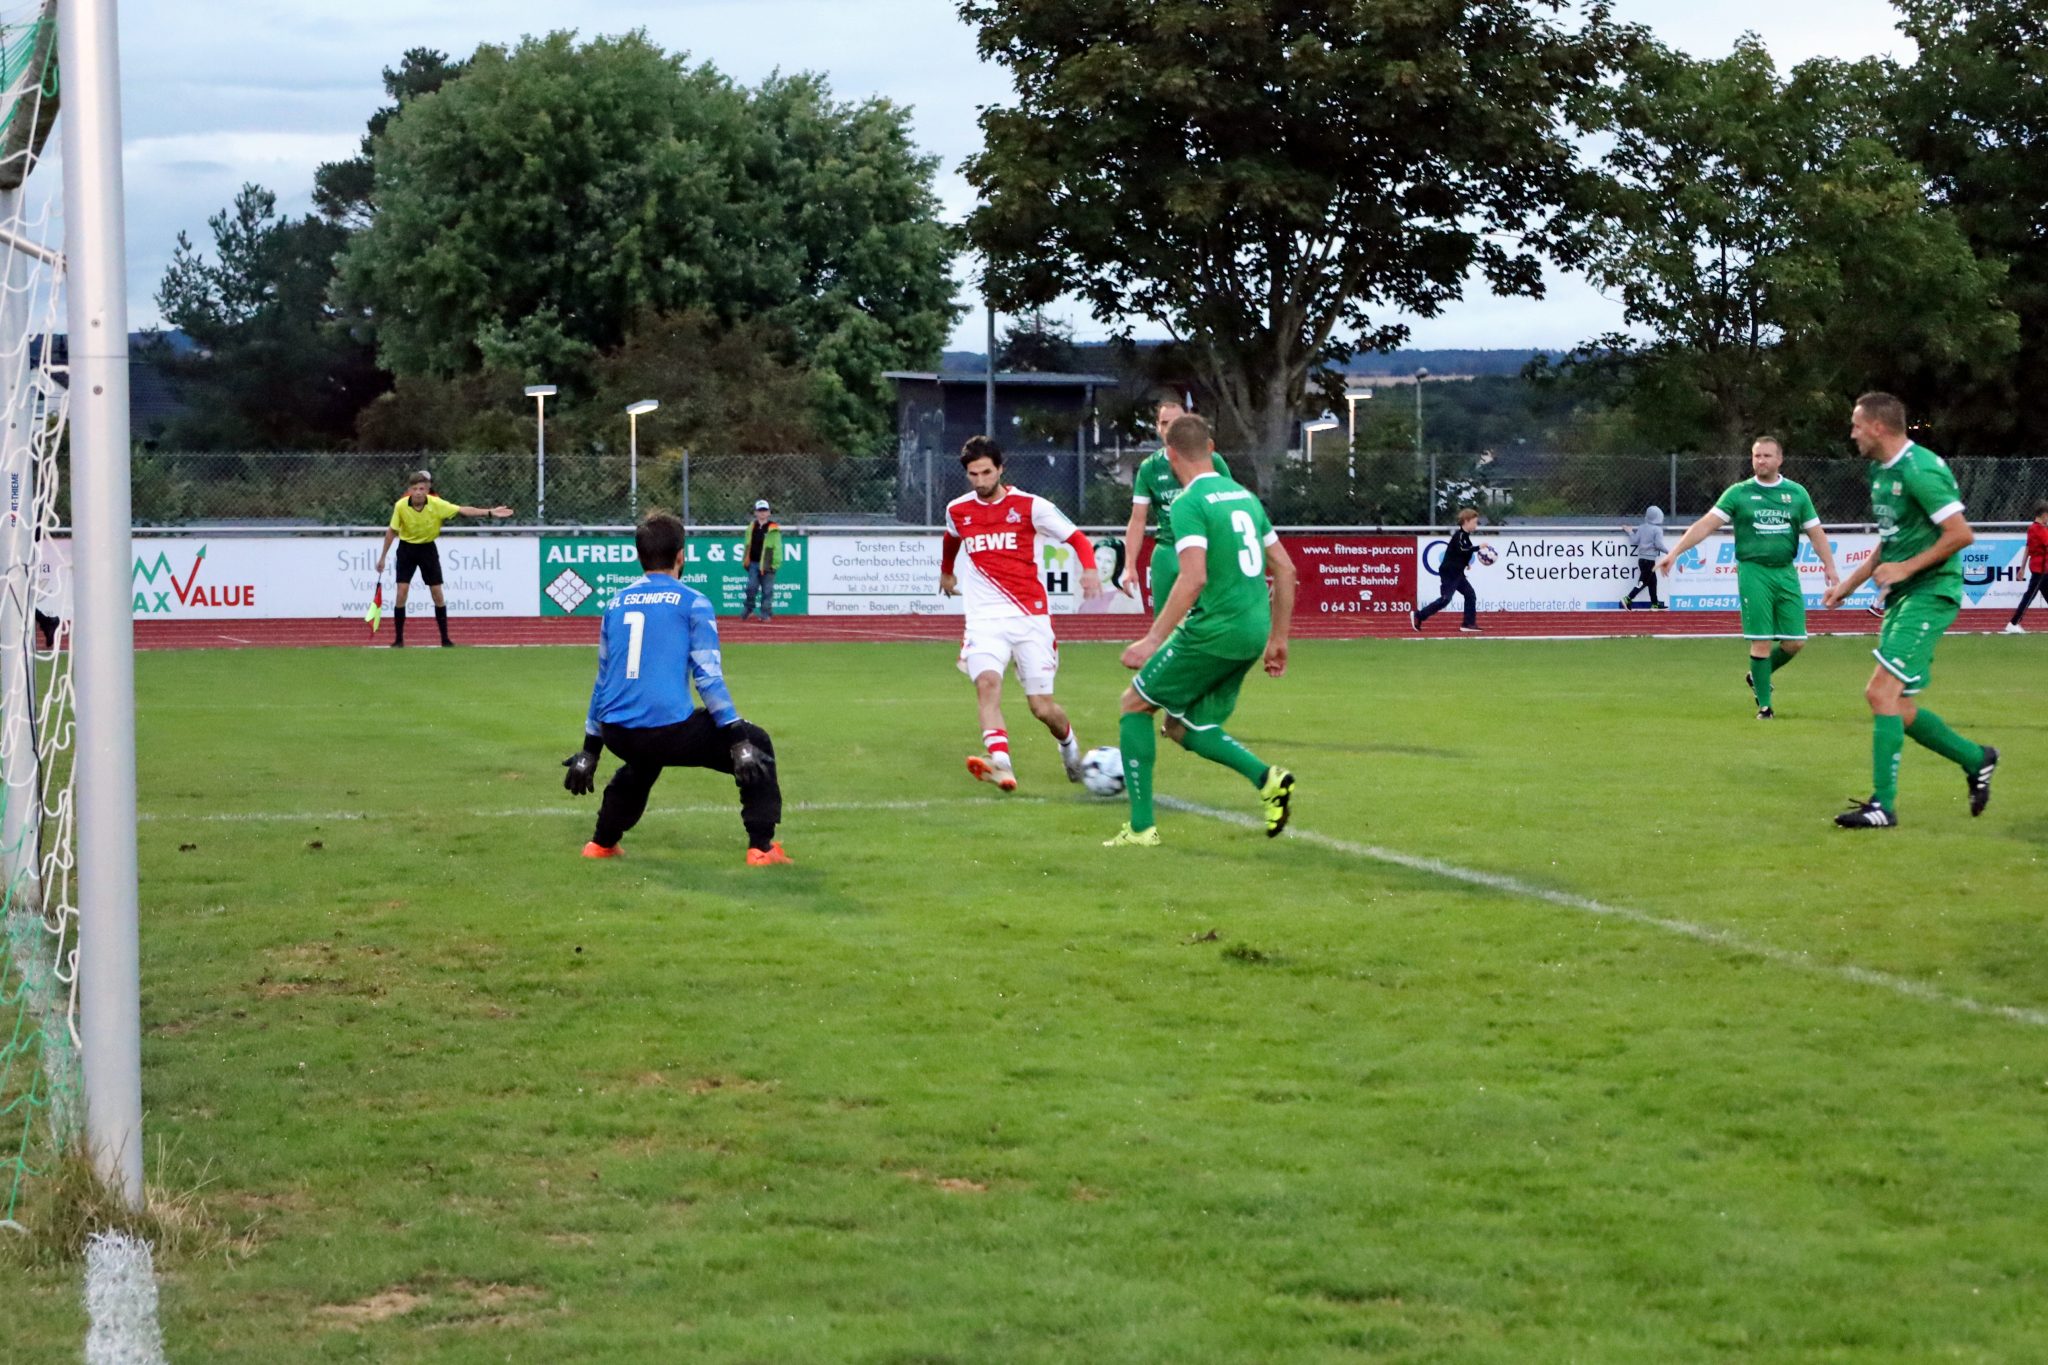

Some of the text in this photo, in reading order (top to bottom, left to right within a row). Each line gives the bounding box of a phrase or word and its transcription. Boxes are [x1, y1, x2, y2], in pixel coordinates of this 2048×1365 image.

[1753, 509, 1791, 519] PIZZERIA
[1760, 516, 1784, 524] CAPRI
[855, 541, 925, 552] Torsten Esch
[965, 532, 1018, 553] REWE
[1231, 510, 1263, 577] 3
[1506, 540, 1639, 557] Andreas Künz
[546, 544, 639, 563] ALFRED
[707, 543, 726, 562] &
[733, 543, 801, 562] SN
[1334, 543, 1413, 556] fitness-pur.com
[832, 555, 942, 567] Gartenbautechnike
[1963, 554, 1989, 562] JOSEF
[1319, 563, 1400, 573] Brüsseler Straße 5
[1506, 562, 1639, 580] Steuerberater
[170, 556, 255, 607] VALUE
[1341, 576, 1398, 585] ICE-Bahnhof
[624, 592, 681, 606] ESCHHOFEN
[1676, 598, 1694, 608] Tel.
[827, 601, 944, 613] Planen Bauen Pflegen
[1320, 602, 1328, 611] 0
[1331, 602, 1345, 611] 64
[1348, 602, 1360, 611] 31
[1373, 602, 1387, 611] 23
[1390, 602, 1411, 611] 330
[623, 611, 645, 679] 1
